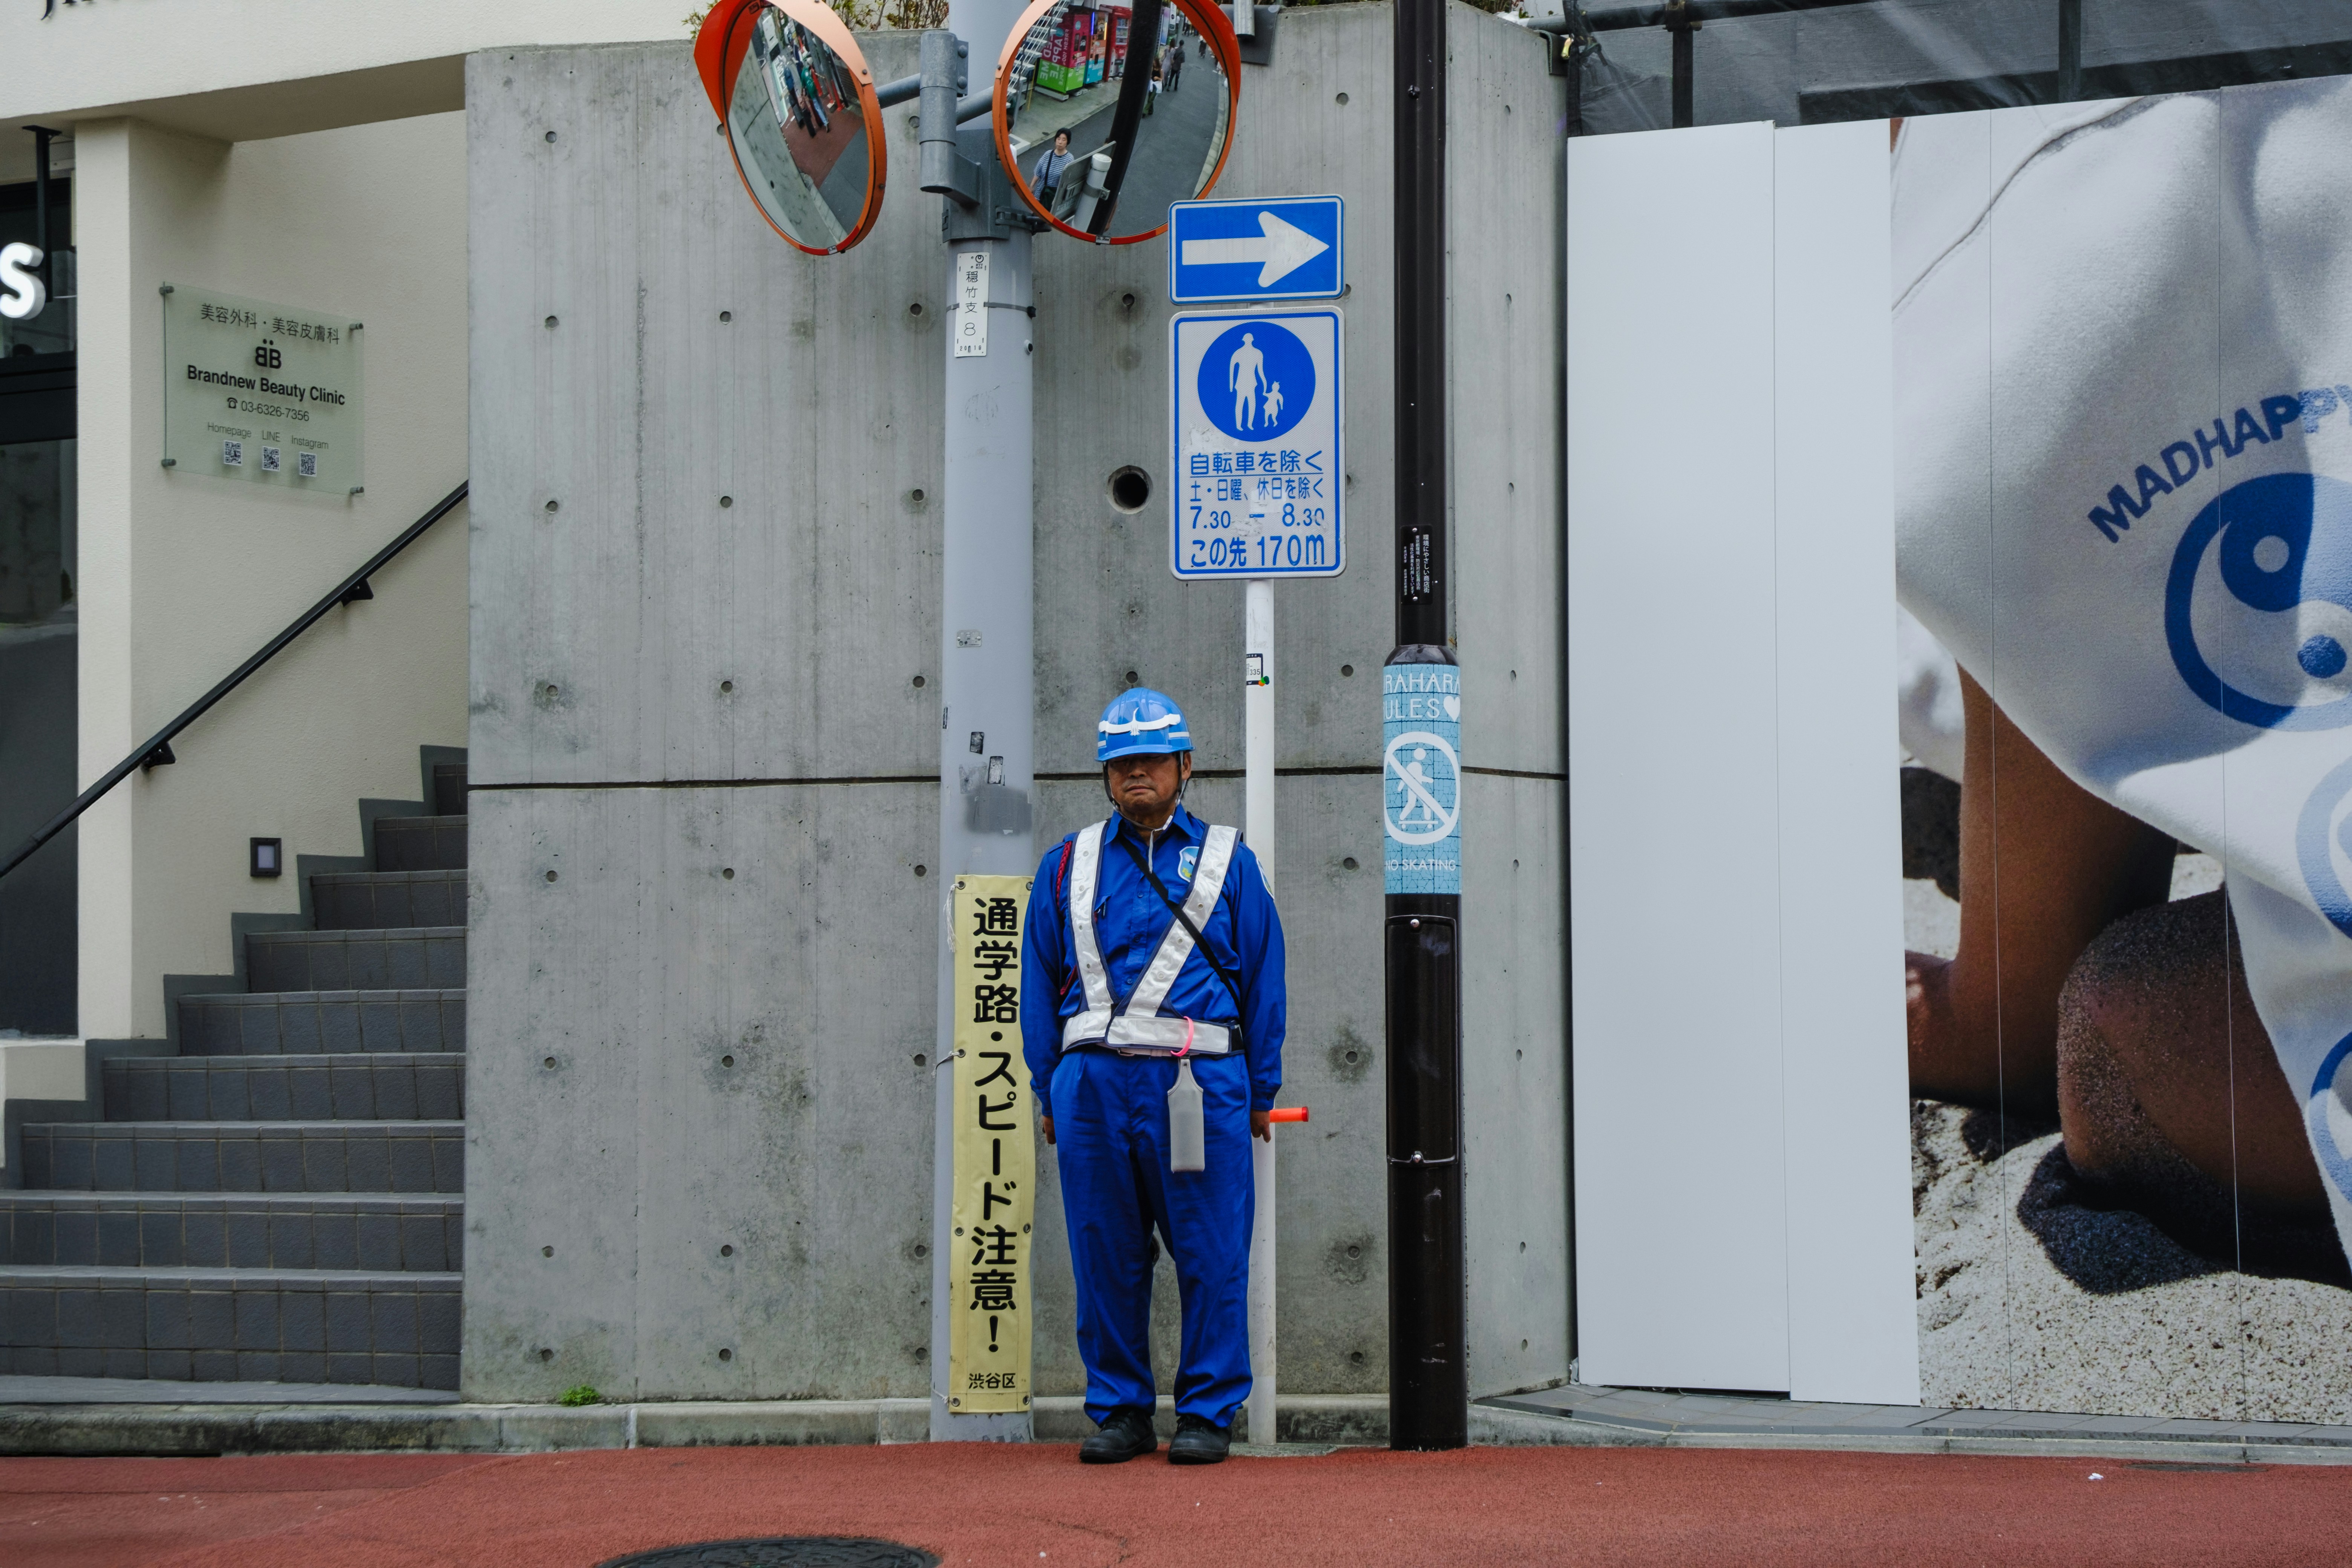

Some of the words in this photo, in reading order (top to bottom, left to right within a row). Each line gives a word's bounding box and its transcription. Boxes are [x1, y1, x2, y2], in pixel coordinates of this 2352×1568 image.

[201, 303, 339, 345] 美容外科・美容皮膚科
[187, 365, 256, 390] Brandnew
[260, 377, 305, 402] Beauty
[310, 386, 345, 405] Clinic
[242, 401, 309, 421] 03-6326-7356
[208, 422, 251, 439] Homepage
[262, 430, 280, 442] LINE
[292, 435, 329, 450] Instagram
[1191, 450, 1322, 475] 自転車を除く
[1190, 506, 1231, 529] 7.30
[1283, 503, 1324, 527] 8.30
[1191, 537, 1246, 567] この先
[1257, 534, 1324, 566] 170m
[1383, 673, 1460, 695] RAHARA
[1383, 698, 1440, 720] ULES
[1386, 859, 1399, 871] NO
[1402, 859, 1456, 871] SKATING
[969, 1373, 1016, 1390] 渋谷区
